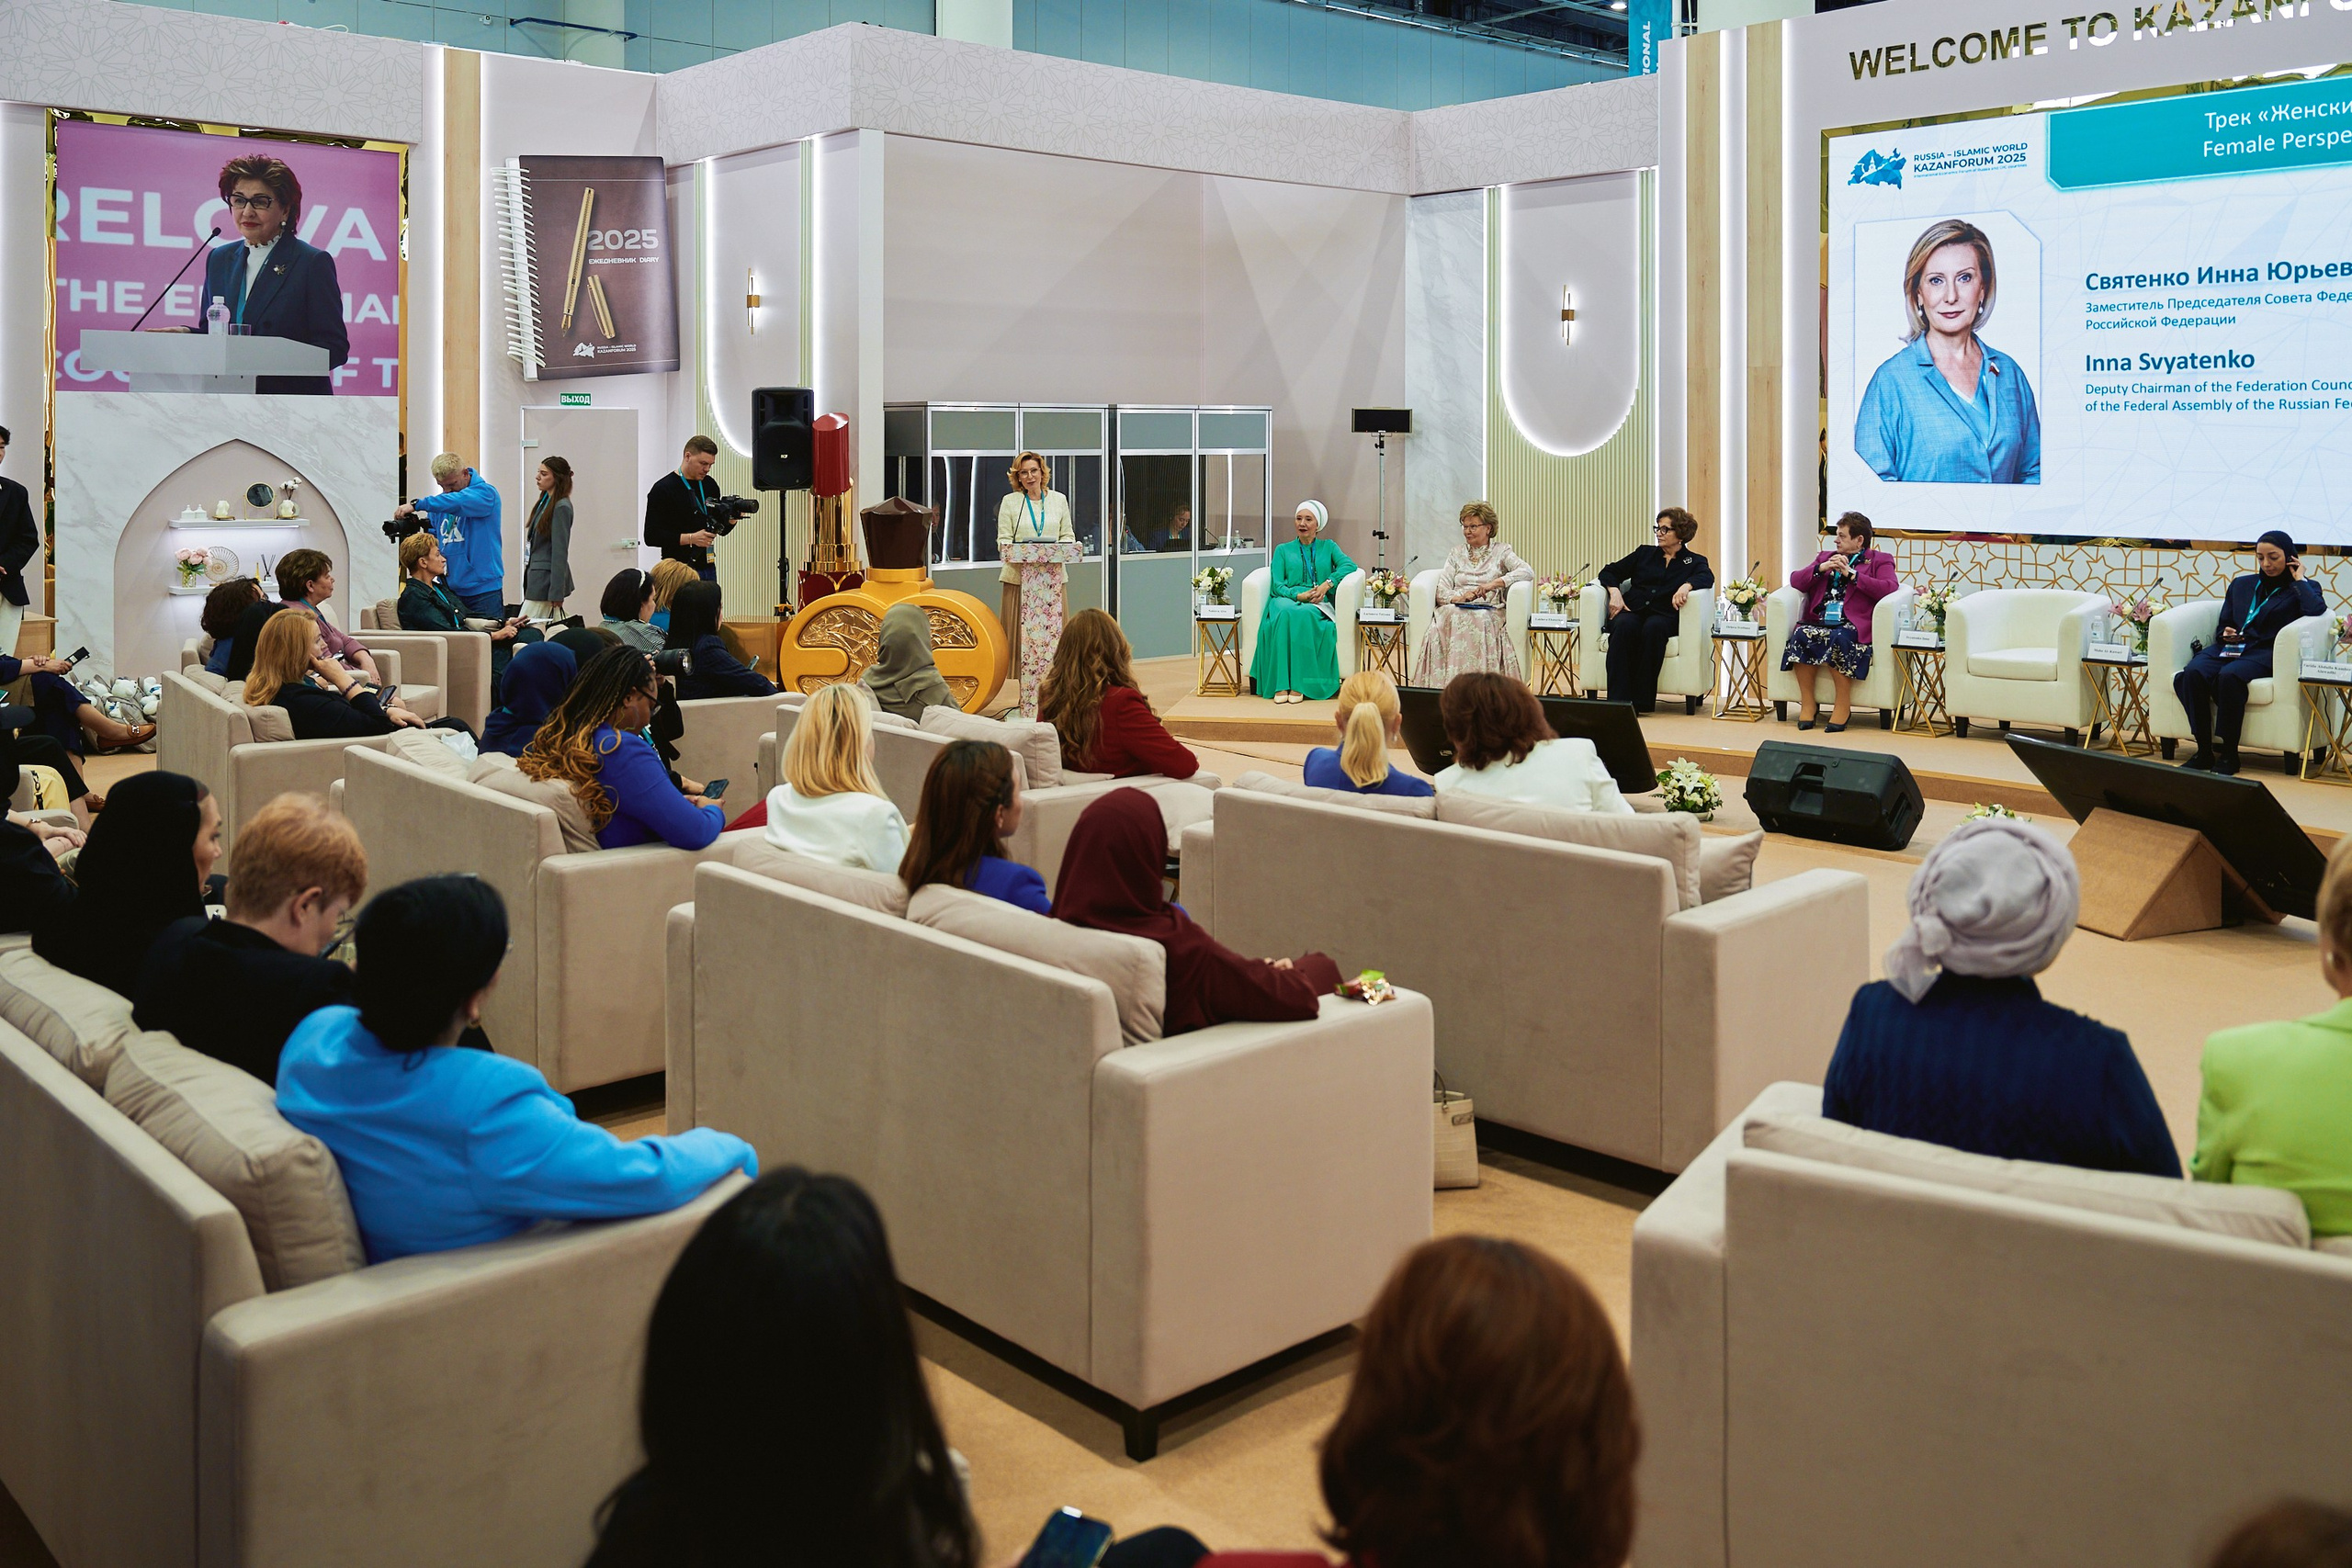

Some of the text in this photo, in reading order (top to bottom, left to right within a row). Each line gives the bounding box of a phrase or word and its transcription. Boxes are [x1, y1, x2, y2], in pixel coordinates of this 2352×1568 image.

[1849, 0, 2352, 80] WELCOME TO KAZAN
[2204, 111, 2252, 132] Трек
[1914, 152, 1945, 162] RUSSIA
[1954, 147, 1990, 157] ISLAMIC
[1993, 142, 2028, 153] WORLD
[2203, 130, 2352, 157] Female Perspe
[1914, 156, 1994, 173] KAZANFORUM
[587, 230, 659, 251] 2025
[2086, 261, 2352, 291] Святенко Инна Юрьев
[2086, 301, 2164, 313] Заместитель
[2167, 296, 2261, 310] Председателя
[2265, 293, 2312, 305] Совета
[2086, 315, 2236, 330] Российской Федерации
[2086, 349, 2256, 375] Inna Svyatenko
[2086, 383, 2129, 396] Deputy
[2132, 382, 2190, 394] Chairman
[2194, 381, 2208, 392] of
[2211, 381, 2233, 392] the
[2236, 380, 2307, 392] Federation
[561, 395, 591, 405] ВЫХОД
[2086, 398, 2352, 412] of the Federal Assembly of the Russian Fe
